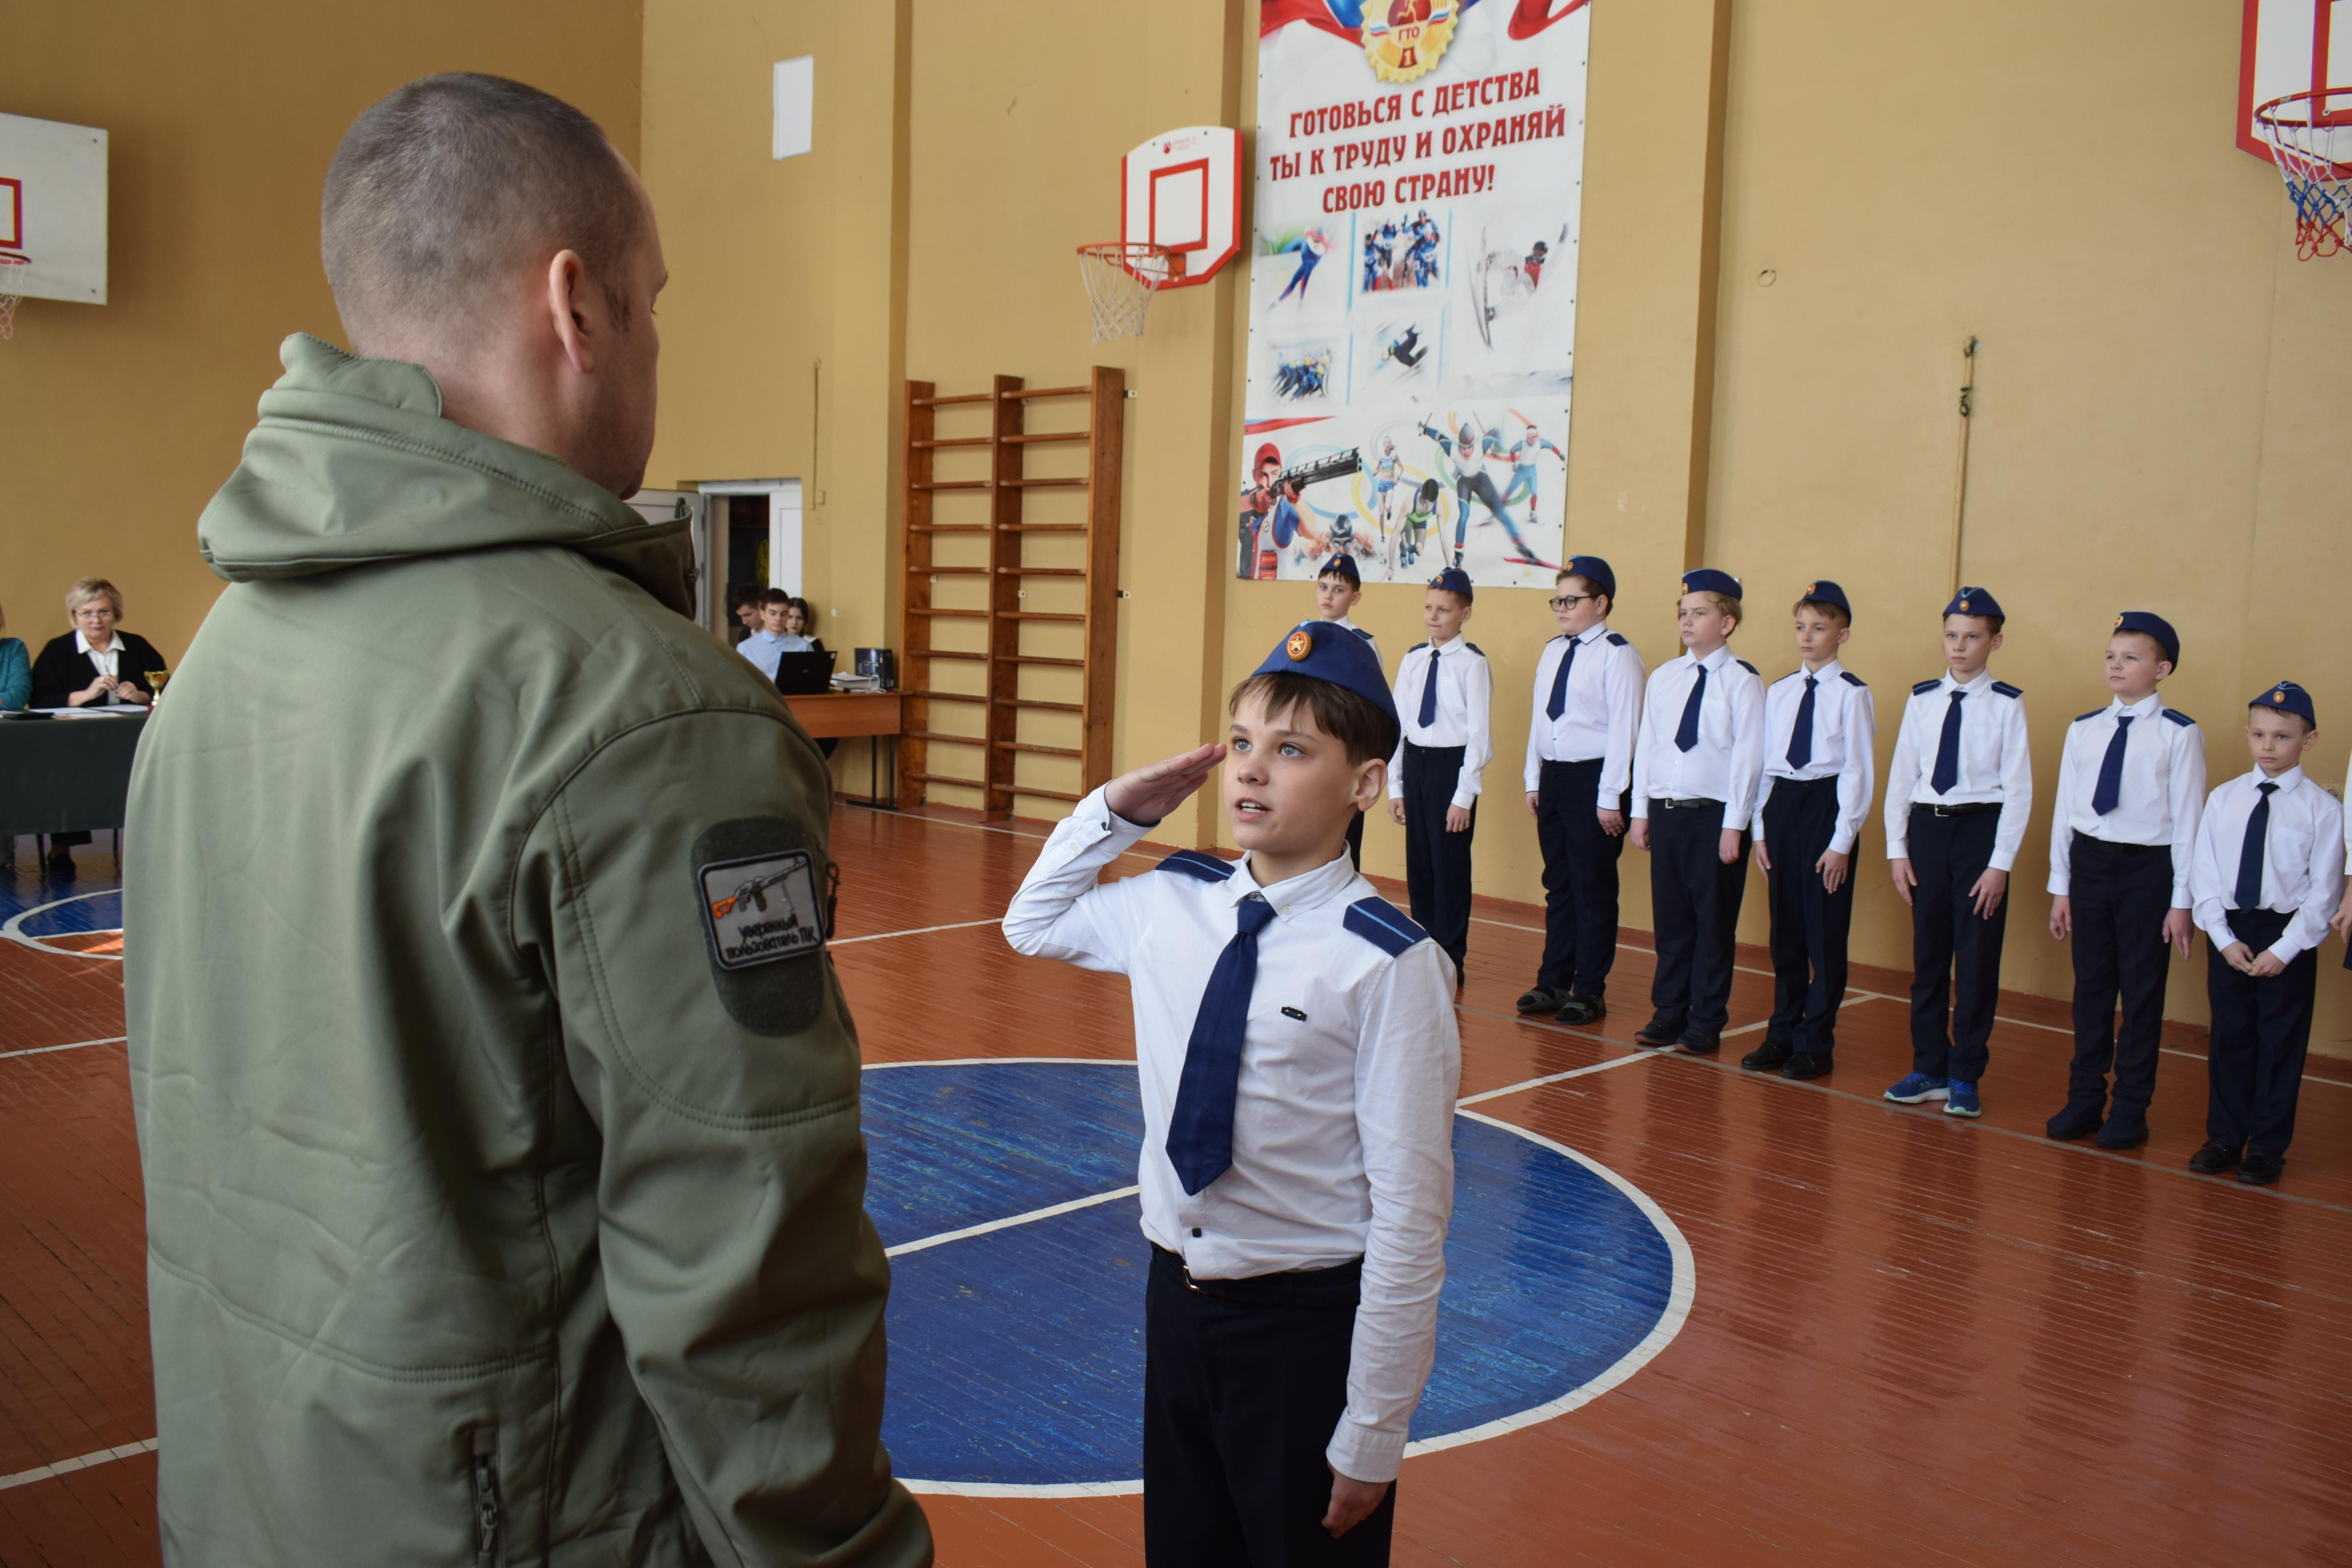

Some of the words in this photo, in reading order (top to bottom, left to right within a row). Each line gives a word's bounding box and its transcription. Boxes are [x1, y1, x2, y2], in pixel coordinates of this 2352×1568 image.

[1399, 26, 1419, 41] ГТО
[1404, 50, 1412, 66] 1
[1289, 93, 1402, 138] ГОТОВЬСЯ
[1412, 89, 1424, 117] С
[1432, 67, 1540, 117] ДЕТСТВА
[1270, 152, 1301, 181] ТЫ
[1310, 148, 1325, 175] К
[1333, 134, 1406, 171] ТРУДУ
[1415, 131, 1433, 159] И
[1442, 103, 1566, 155] ОХРАНЯЙ
[1323, 180, 1385, 213] СВОЮ
[1395, 164, 1495, 203] СТРАНУ!
[726, 932, 799, 960] пользователь
[799, 925, 818, 944] ПК
